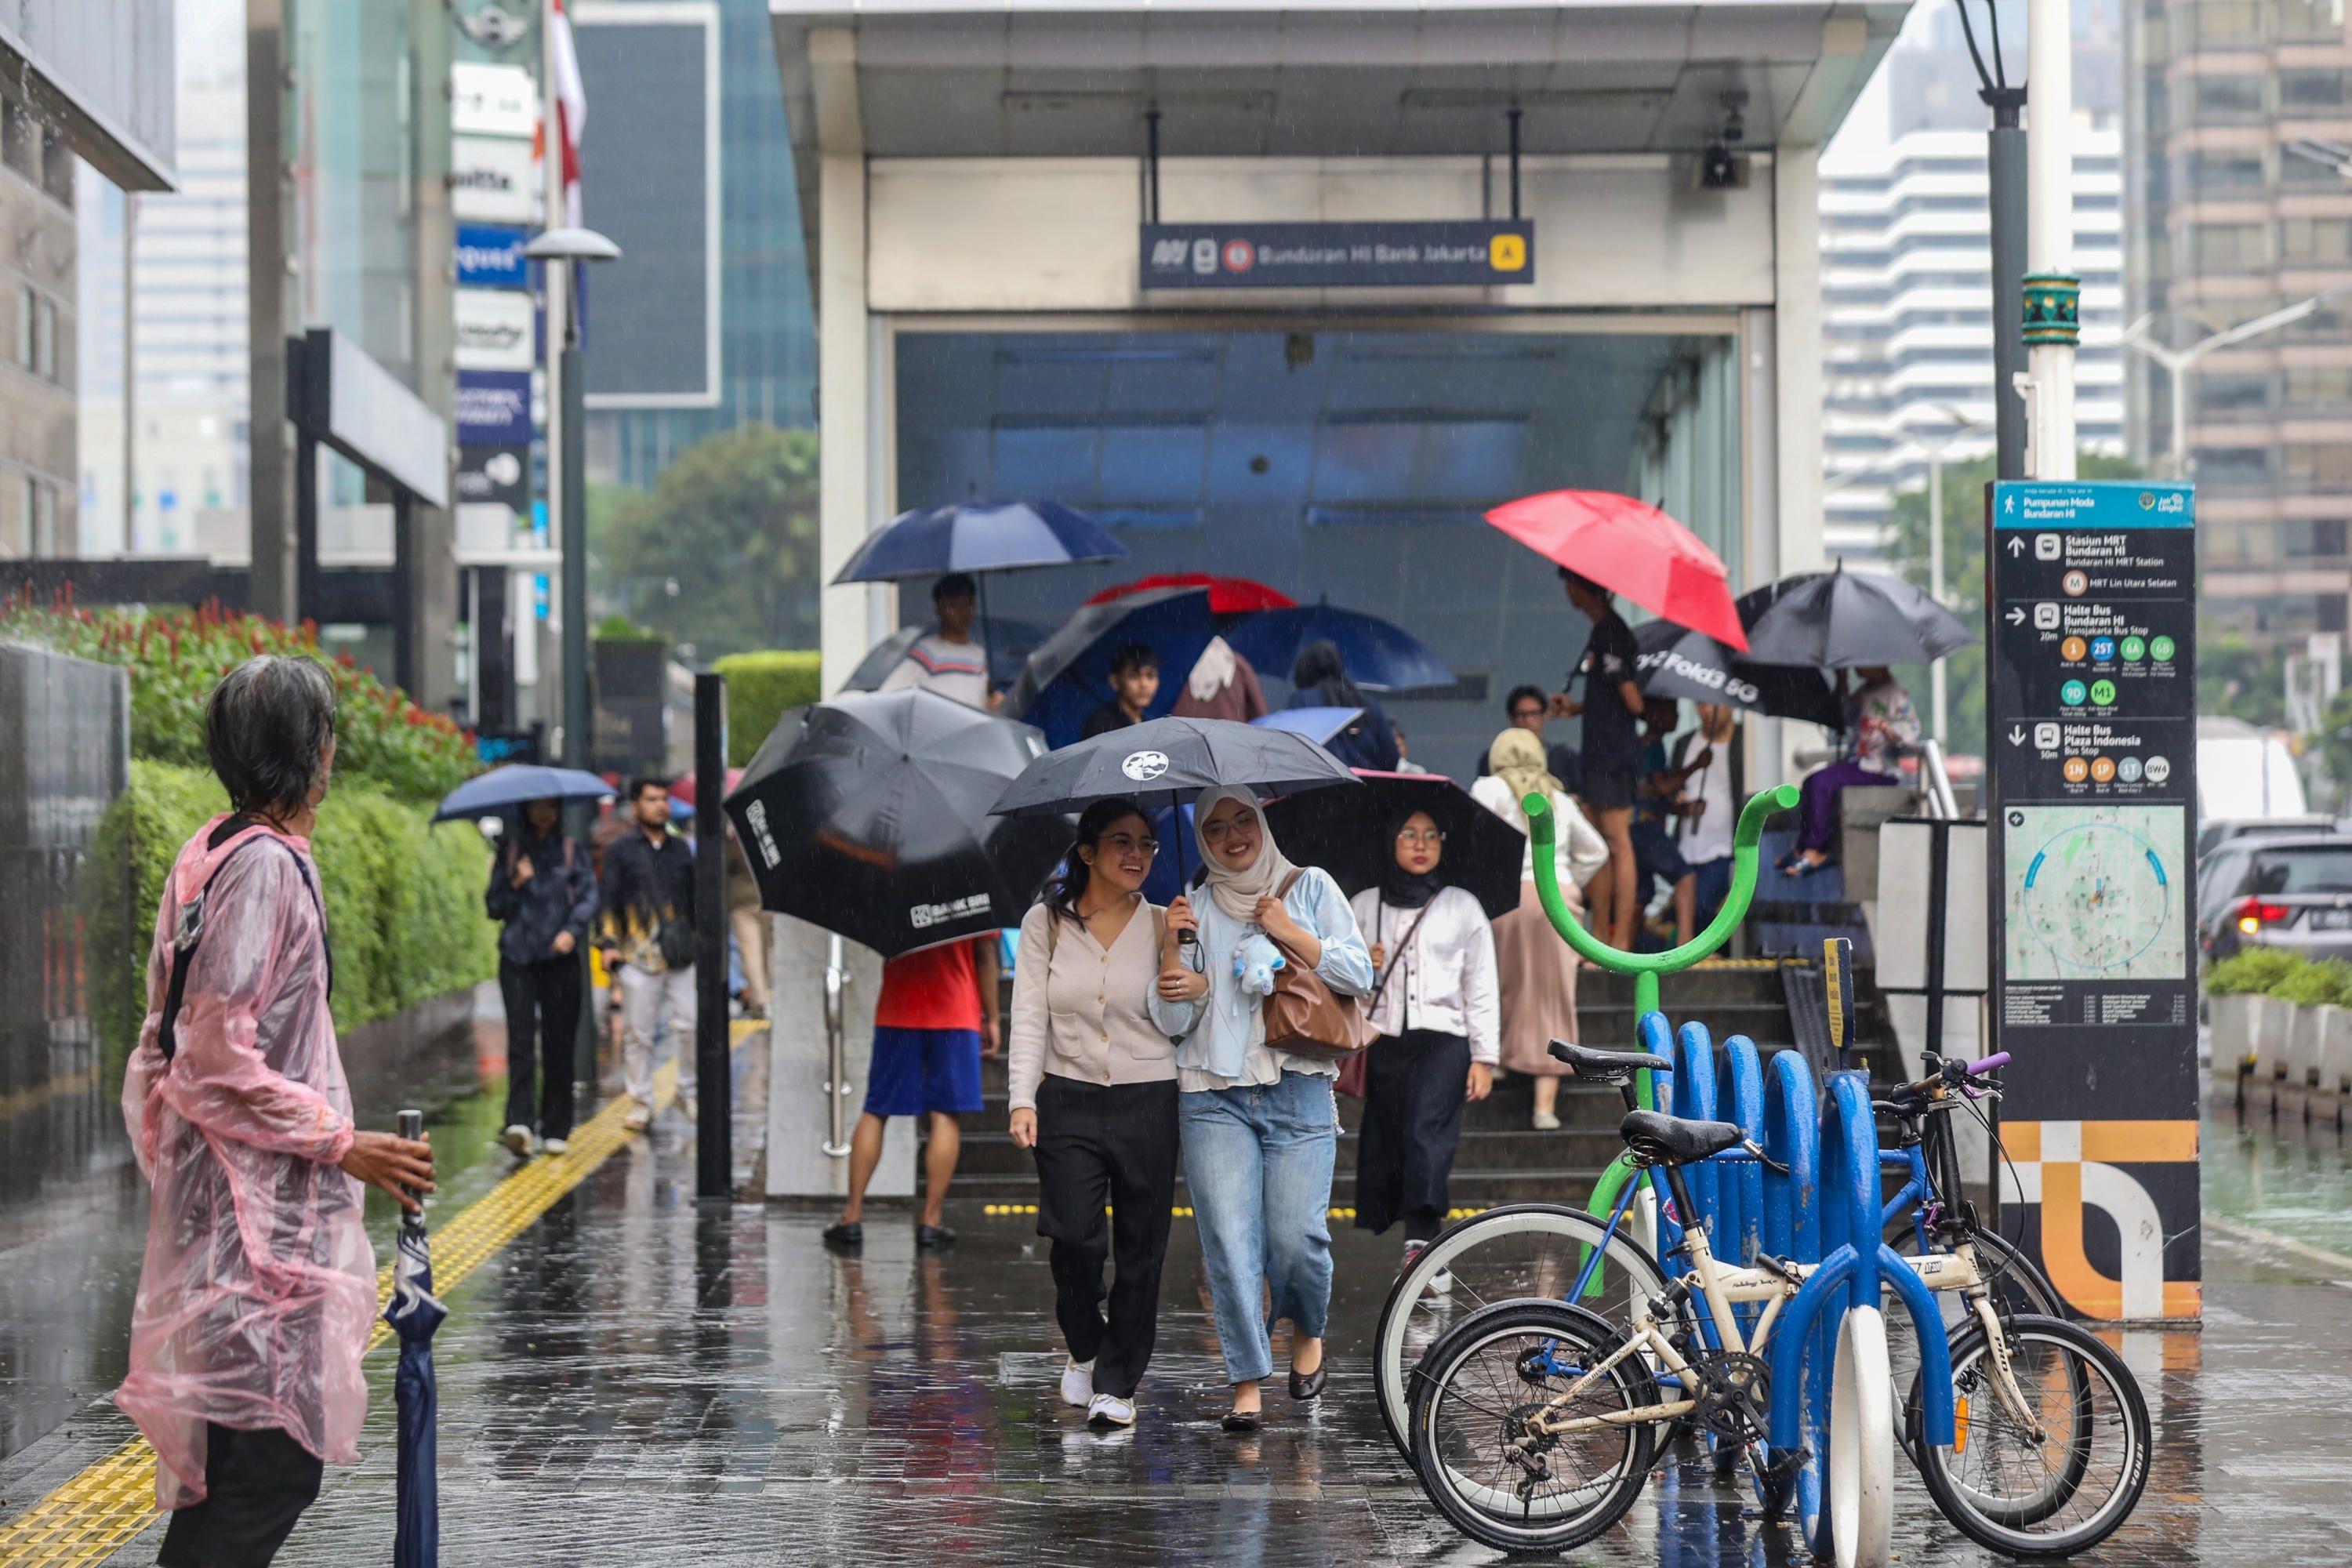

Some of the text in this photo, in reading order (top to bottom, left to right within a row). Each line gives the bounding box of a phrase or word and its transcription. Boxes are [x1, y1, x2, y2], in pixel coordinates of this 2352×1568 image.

[1423, 244, 1487, 263] Jakarta
[1501, 246, 1513, 260] A
[2024, 497, 2095, 509] Pumpunan Moda
[2024, 509, 2076, 518] Bundaran HI
[2066, 535, 2127, 546] Stasiun MRT
[2066, 546, 2126, 556] Bundaran HI
[2066, 557, 2164, 567] Bundaran HI MRT Station
[2070, 578, 2080, 588] M
[2090, 579, 2176, 587] MRT Lin Utara Selatan
[2064, 605, 2111, 615] Halte Bus
[2064, 616, 2124, 626] Bundaran HI
[2064, 626, 2148, 636] Transjakarta Bus Stop
[2040, 632, 2058, 641] 20m
[2069, 644, 2077, 654] 1
[2125, 644, 2140, 654] 6A
[1664, 652, 1726, 689] Fold3
[1726, 677, 1759, 703] 5G
[2067, 688, 2082, 699] 9D
[2094, 688, 2111, 699] M1
[2064, 725, 2111, 735] Halte Bus
[2064, 735, 2141, 746] Plaza Indonesia
[2040, 751, 2058, 760] 30m
[2064, 746, 2099, 756] Bus Stop
[2068, 764, 2083, 775] 1N
[2096, 764, 2110, 775] 1P
[2123, 764, 2137, 775] 1T
[2147, 764, 2167, 774] BW4
[1994, 1336, 2009, 1372] PRO
[2130, 1442, 2144, 1486] KENDA
